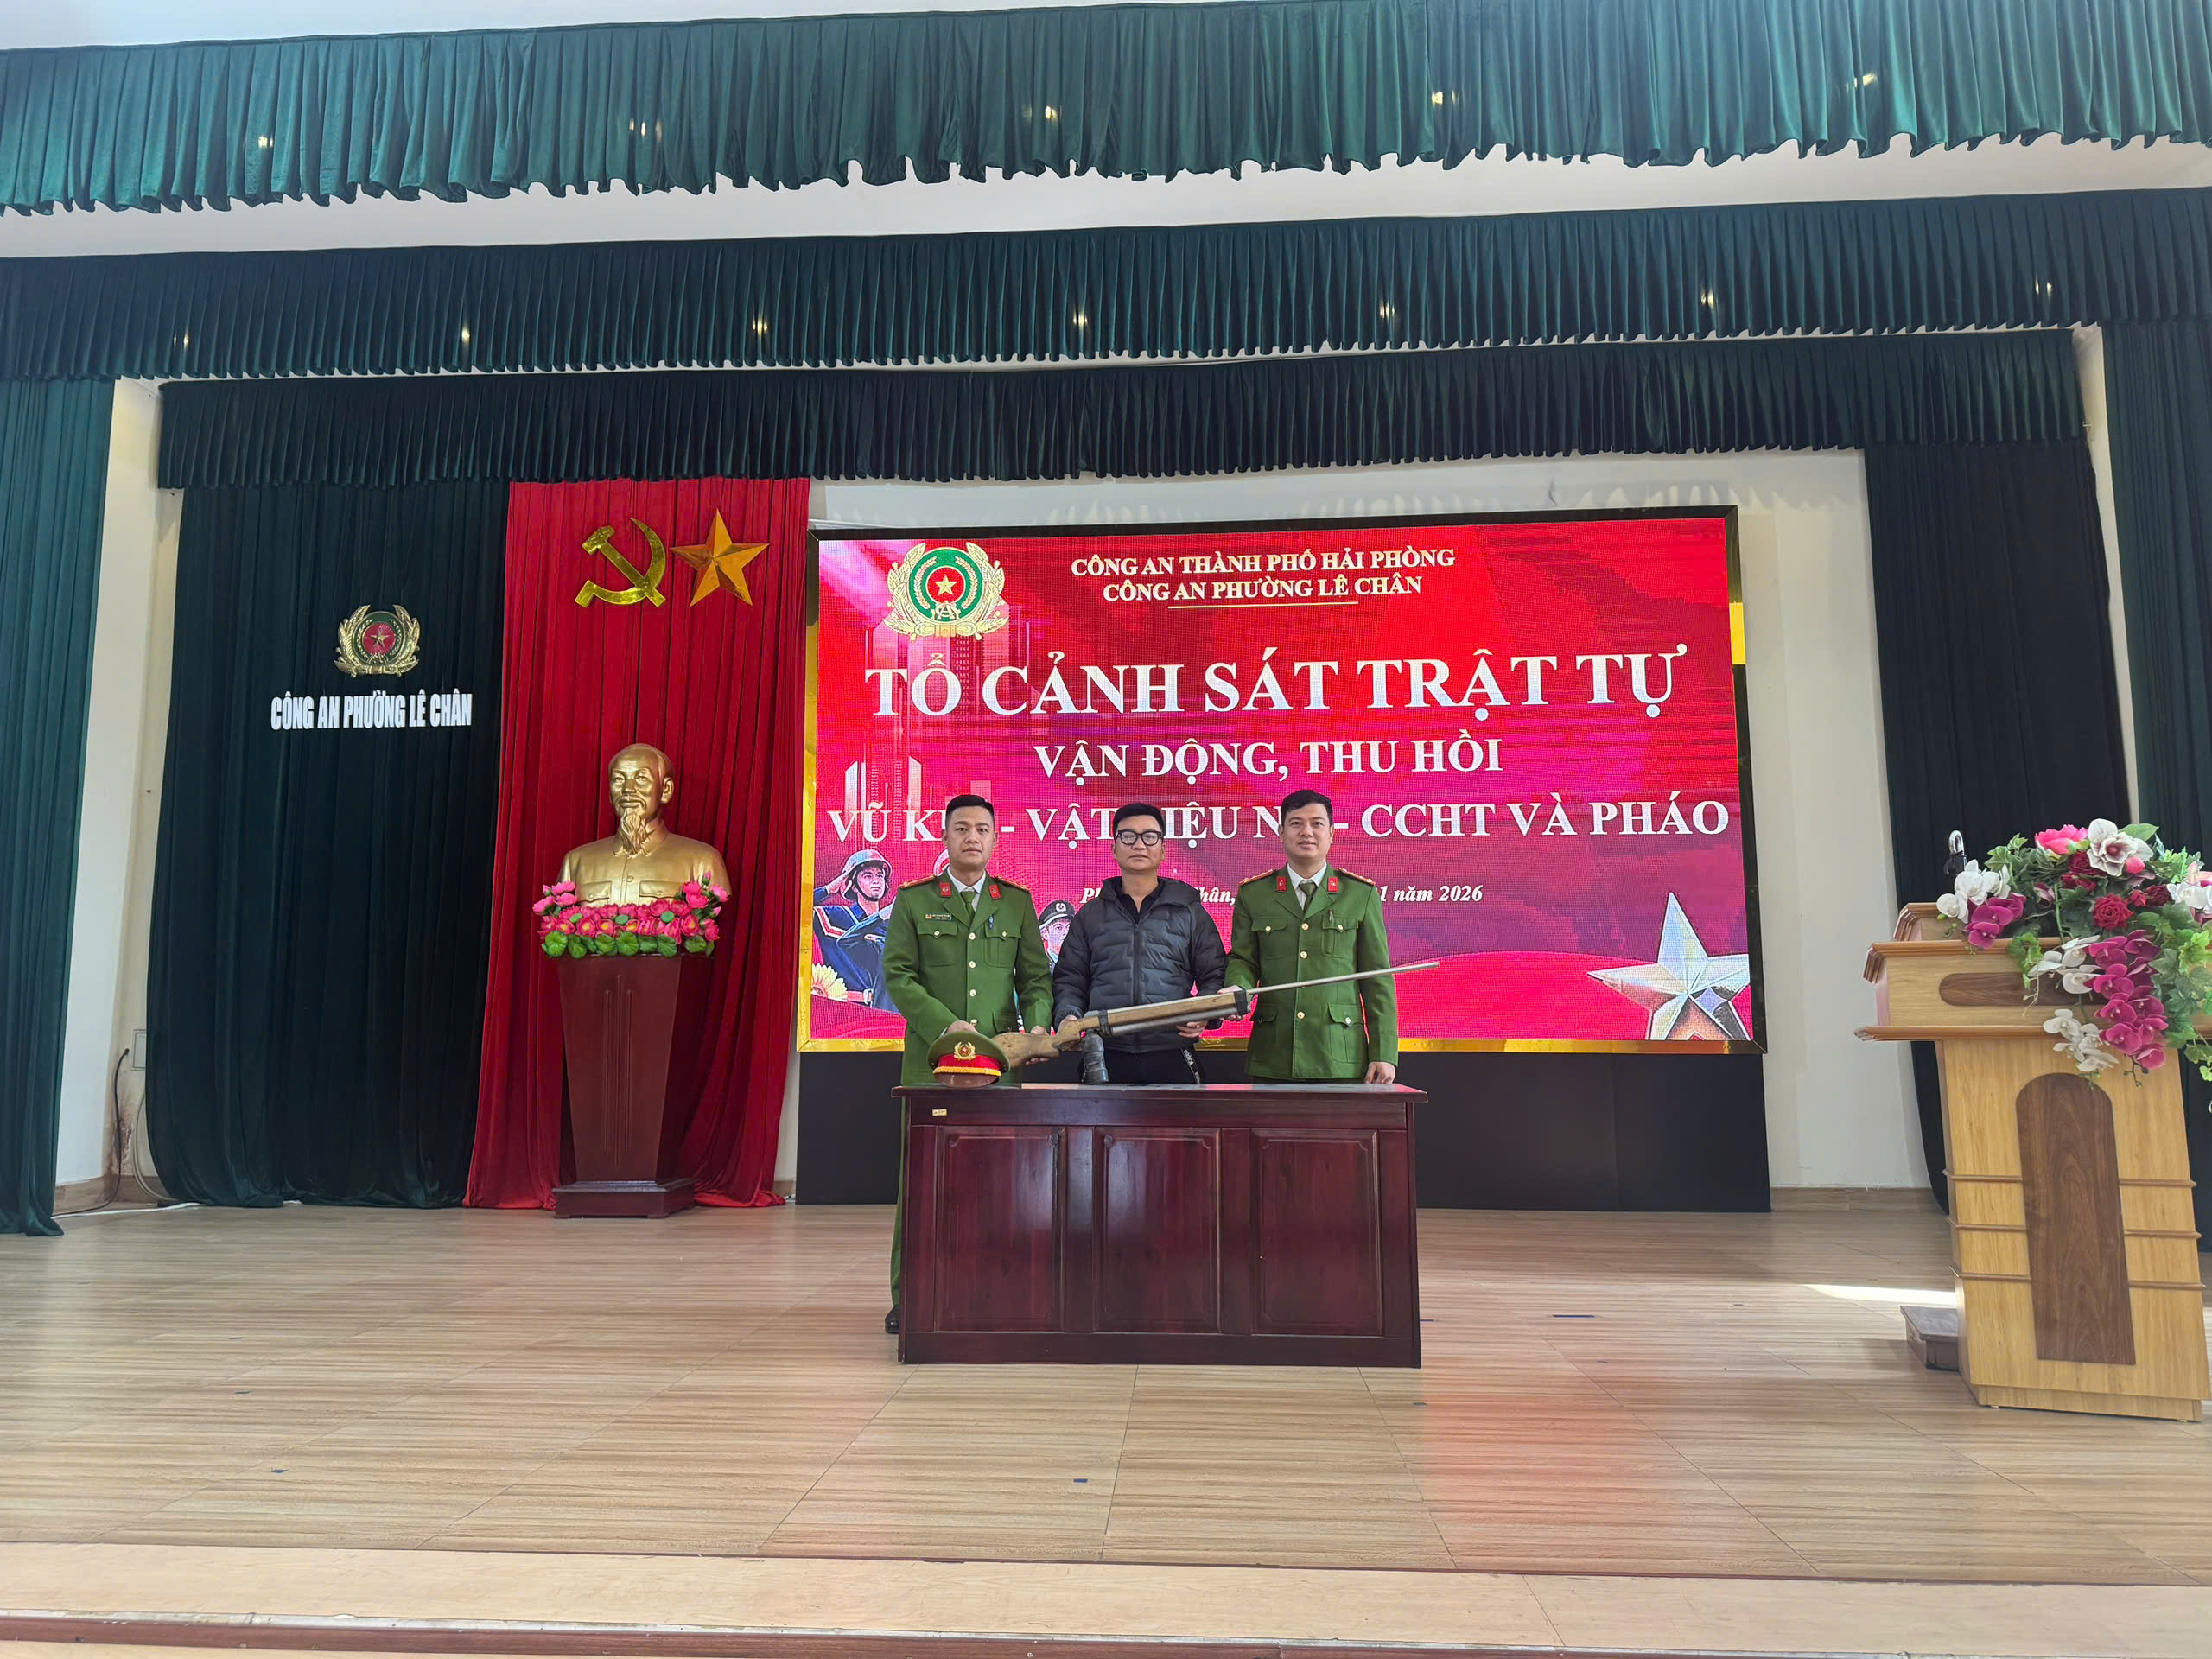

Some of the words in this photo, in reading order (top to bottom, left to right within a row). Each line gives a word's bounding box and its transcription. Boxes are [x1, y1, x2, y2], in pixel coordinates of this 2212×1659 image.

[1071, 553, 1139, 576] CÔNG
[1141, 556, 1175, 575] AN
[1179, 550, 1262, 574] THÀNH
[1266, 548, 1317, 571] PHỐ
[1320, 547, 1365, 570] HẢI
[1370, 545, 1456, 568] PHÒNG
[1103, 578, 1171, 601] CÔNG
[1173, 582, 1207, 600] AN
[1211, 575, 1313, 599] PHƯỜNG
[1317, 573, 1349, 596] LÊ
[1354, 572, 1423, 595] CHÂN
[864, 652, 962, 716] TỔ
[981, 651, 1185, 715] CẢNH
[1204, 646, 1338, 713] SÁT
[1357, 648, 1558, 721] TRẬT
[1575, 643, 1688, 718] TỰ
[270, 690, 315, 730] CÔNG
[317, 696, 340, 729] AN
[343, 690, 406, 729] PHƯỜNG
[409, 688, 427, 728] LÊ
[429, 687, 474, 727] CHÂN
[1033, 739, 1131, 785] VẬN
[1141, 737, 1290, 785] ĐỘNG,
[1299, 740, 1398, 775] THU
[1411, 728, 1503, 772] HỒI
[827, 801, 892, 843] VŨ
[1025, 802, 1120, 849] VẬT
[1160, 801, 1243, 849] IỆU
[1252, 805, 1282, 838] N
[1361, 800, 1496, 839] CCHT
[1506, 791, 1578, 836] VÀ
[1588, 791, 1730, 836] PHÁO
[1194, 886, 1236, 906] hân,
[1393, 885, 1433, 902] năm
[1437, 884, 1484, 902] 2026
